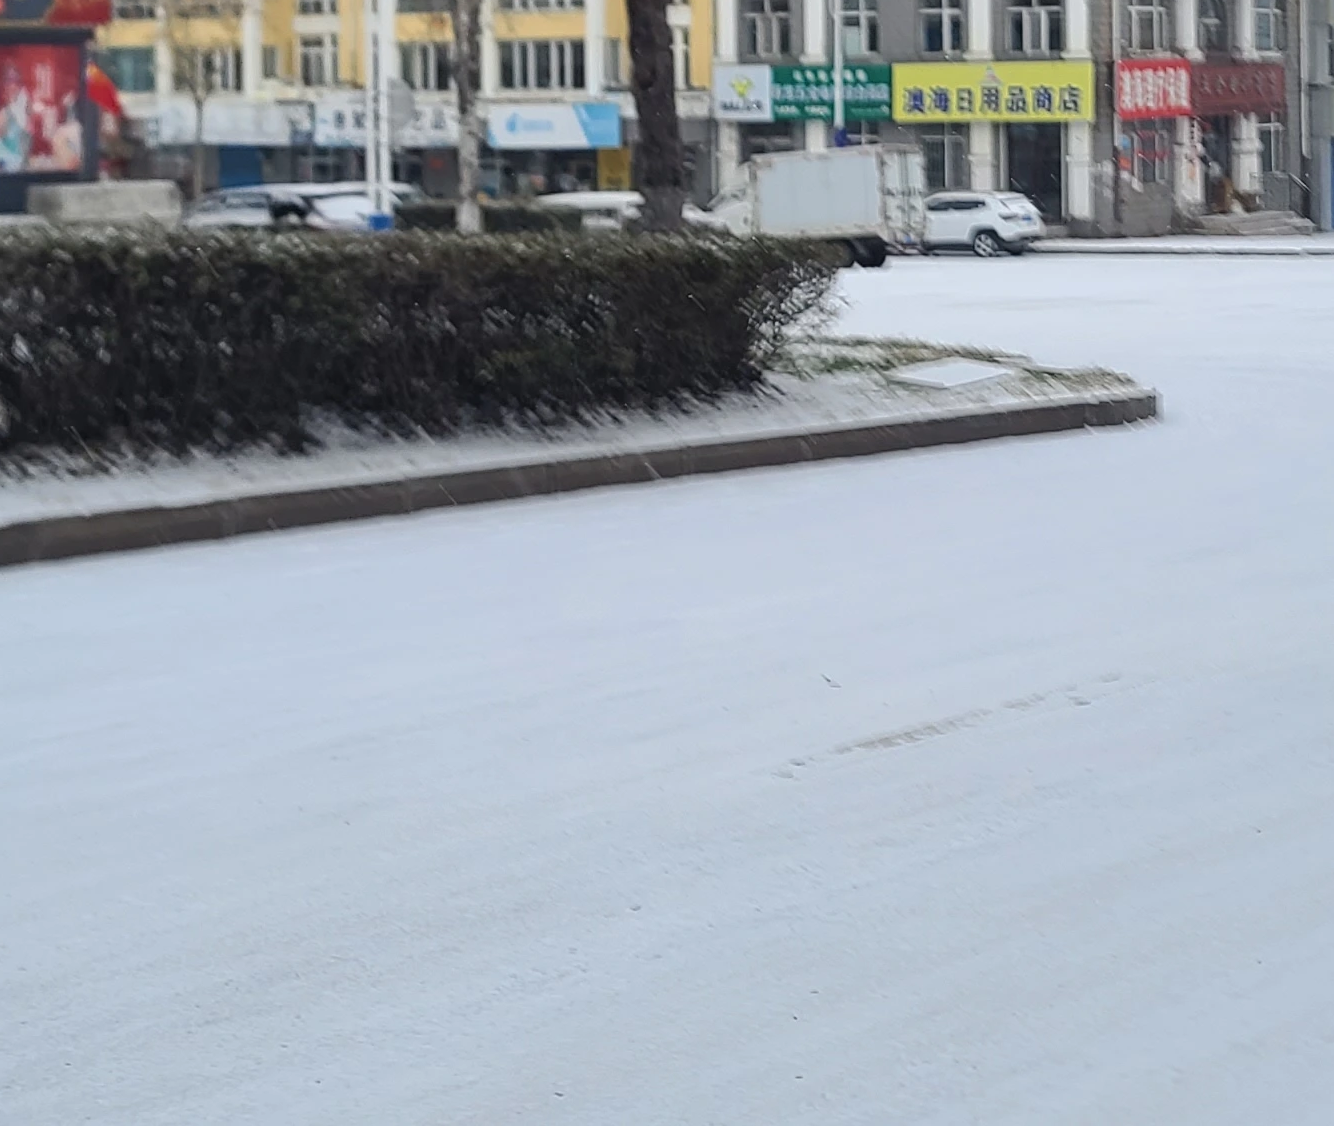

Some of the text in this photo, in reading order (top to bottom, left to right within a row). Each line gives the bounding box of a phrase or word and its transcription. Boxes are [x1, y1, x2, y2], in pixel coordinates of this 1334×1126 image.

[903, 84, 1081, 115] 澳海日用品商店
